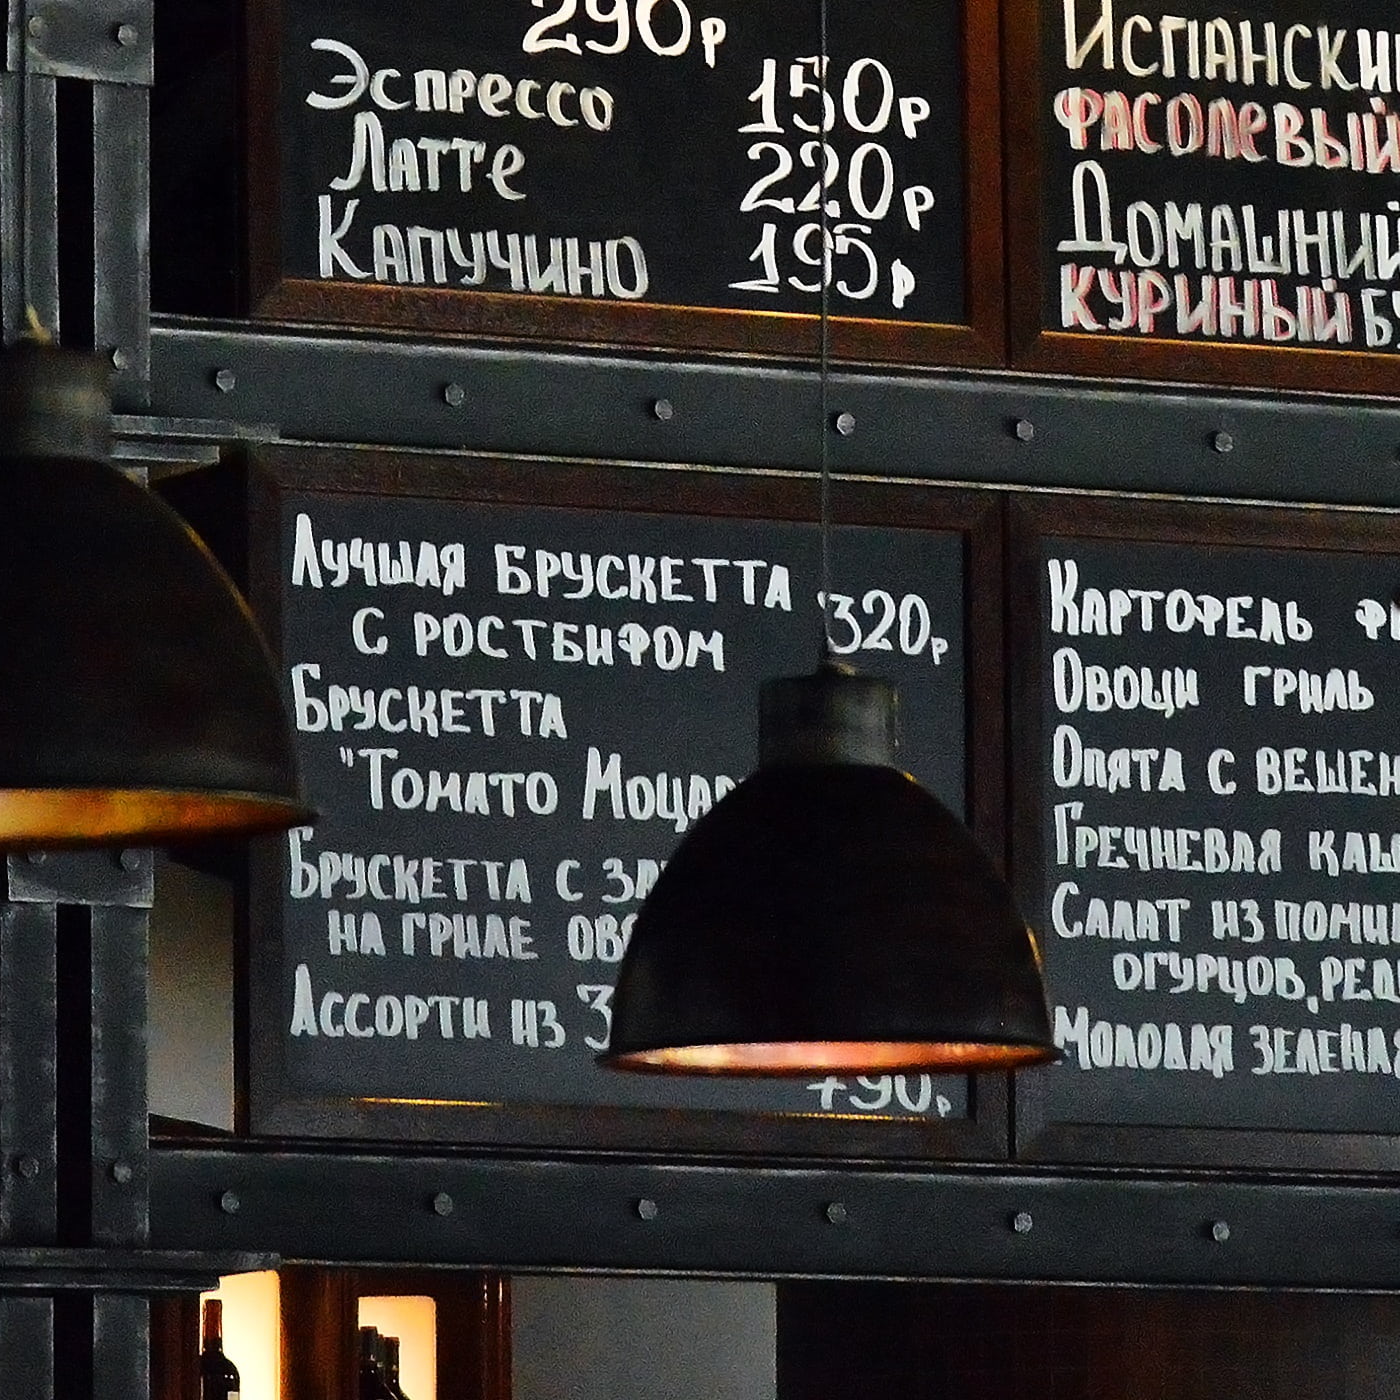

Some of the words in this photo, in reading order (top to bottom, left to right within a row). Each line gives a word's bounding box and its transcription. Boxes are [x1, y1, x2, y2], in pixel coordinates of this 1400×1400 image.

[319, 194, 648, 300] КАПУЧИНО
[1056, 261, 1355, 344] КУРИНЫЙ
[292, 513, 465, 595] ЛУЧШАЯ
[495, 544, 792, 611] БРУСКЕТТА
[353, 607, 388, 654] С
[414, 612, 725, 672] РОСТБИФОМ
[1048, 559, 1313, 645] КАРТОФЕЛЬ
[291, 663, 567, 739] БРУСКЕТТА
[1053, 647, 1199, 718] ОВОЩИ
[1244, 666, 1374, 714] ГРИЛЬ
[583, 747, 738, 833] МОЦАР
[1053, 724, 1186, 793] ОПЯТА
[1208, 749, 1236, 795] С
[288, 826, 531, 903] БРУСКЕТТА
[556, 860, 583, 901] С
[602, 858, 667, 903] ЗА
[1054, 801, 1281, 874] ГРЕЧНЕВАЯ
[328, 910, 386, 956] НА
[402, 913, 538, 960] ГРИЛЕ
[1052, 882, 1190, 942] САЛАТ
[1211, 899, 1264, 943] ИЗ
[291, 964, 491, 1039] АССОРТИ
[511, 999, 565, 1048] ИЗ
[1053, 1006, 1234, 1078] МОЛОДАЯ
